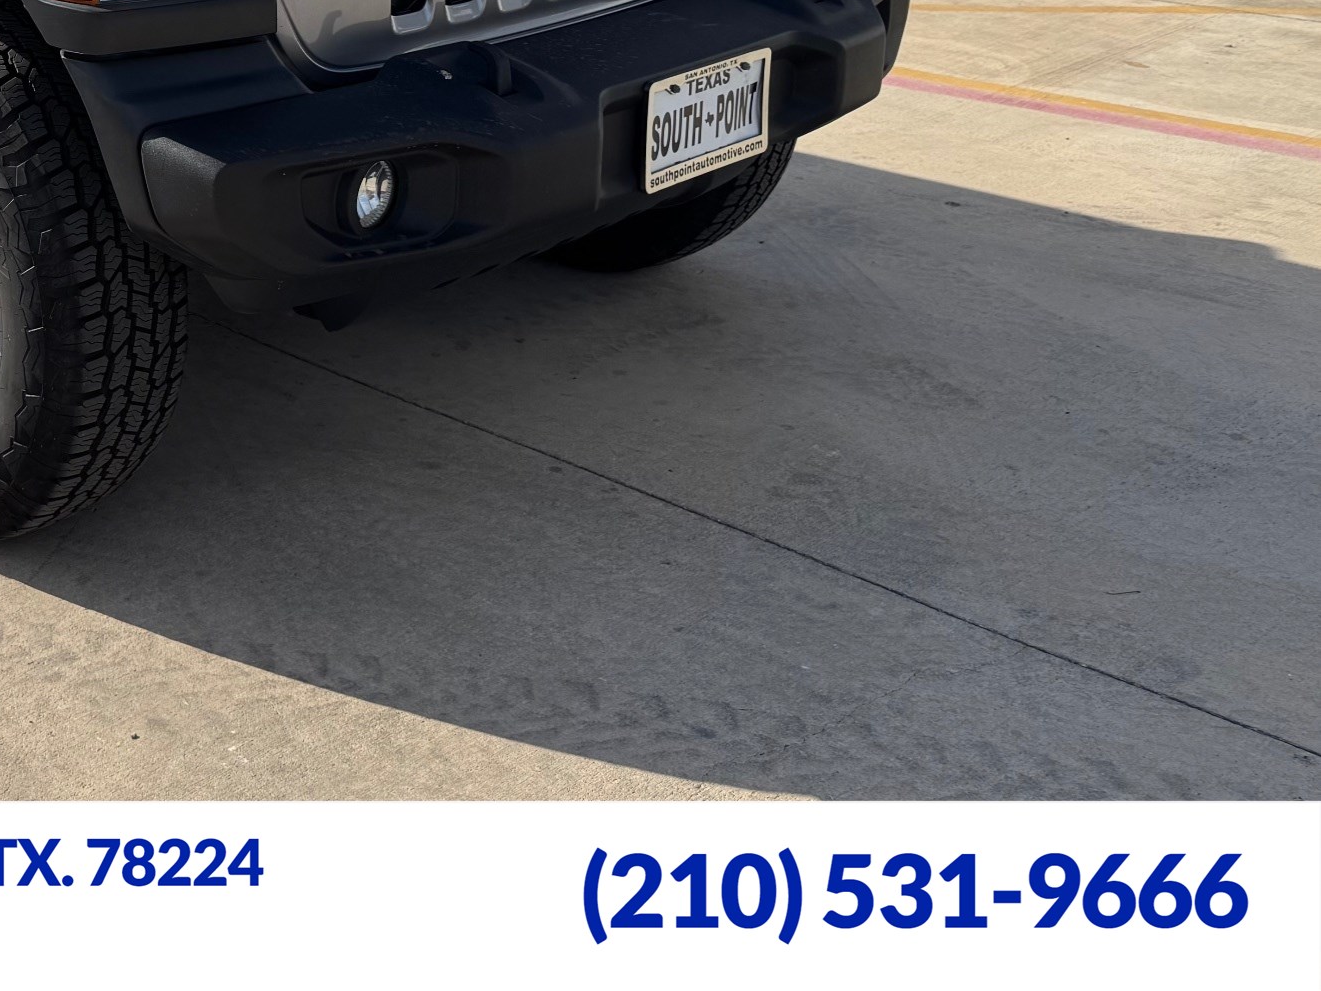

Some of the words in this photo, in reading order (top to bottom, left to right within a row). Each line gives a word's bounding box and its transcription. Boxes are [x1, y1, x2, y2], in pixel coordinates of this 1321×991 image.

[684, 71, 698, 80] SAN
[686, 68, 731, 96] TEXAS
[650, 100, 704, 162] SOUTH
[715, 81, 758, 138] POINT
[649, 139, 764, 188] southpointautomotive.com
